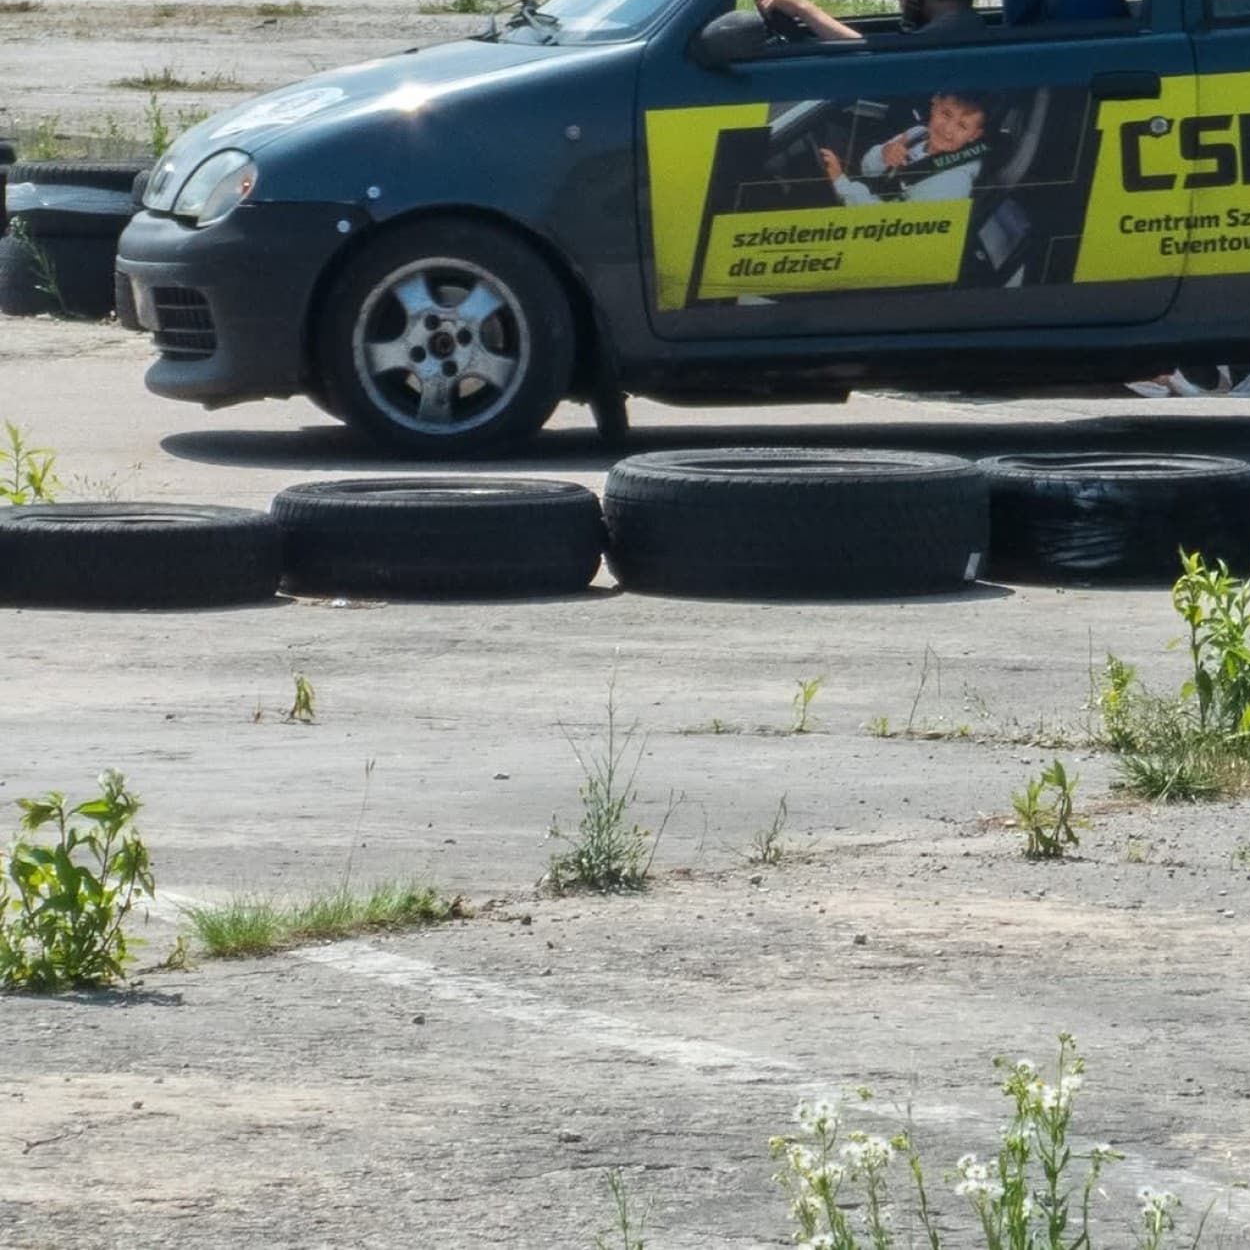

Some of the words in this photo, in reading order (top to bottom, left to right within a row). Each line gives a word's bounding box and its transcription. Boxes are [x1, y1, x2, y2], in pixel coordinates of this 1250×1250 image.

[732, 222, 847, 248] szkolenia
[851, 219, 951, 242] rajdowe
[1119, 213, 1220, 234] Centrum
[728, 258, 768, 277] dla
[772, 252, 843, 274] dzieci
